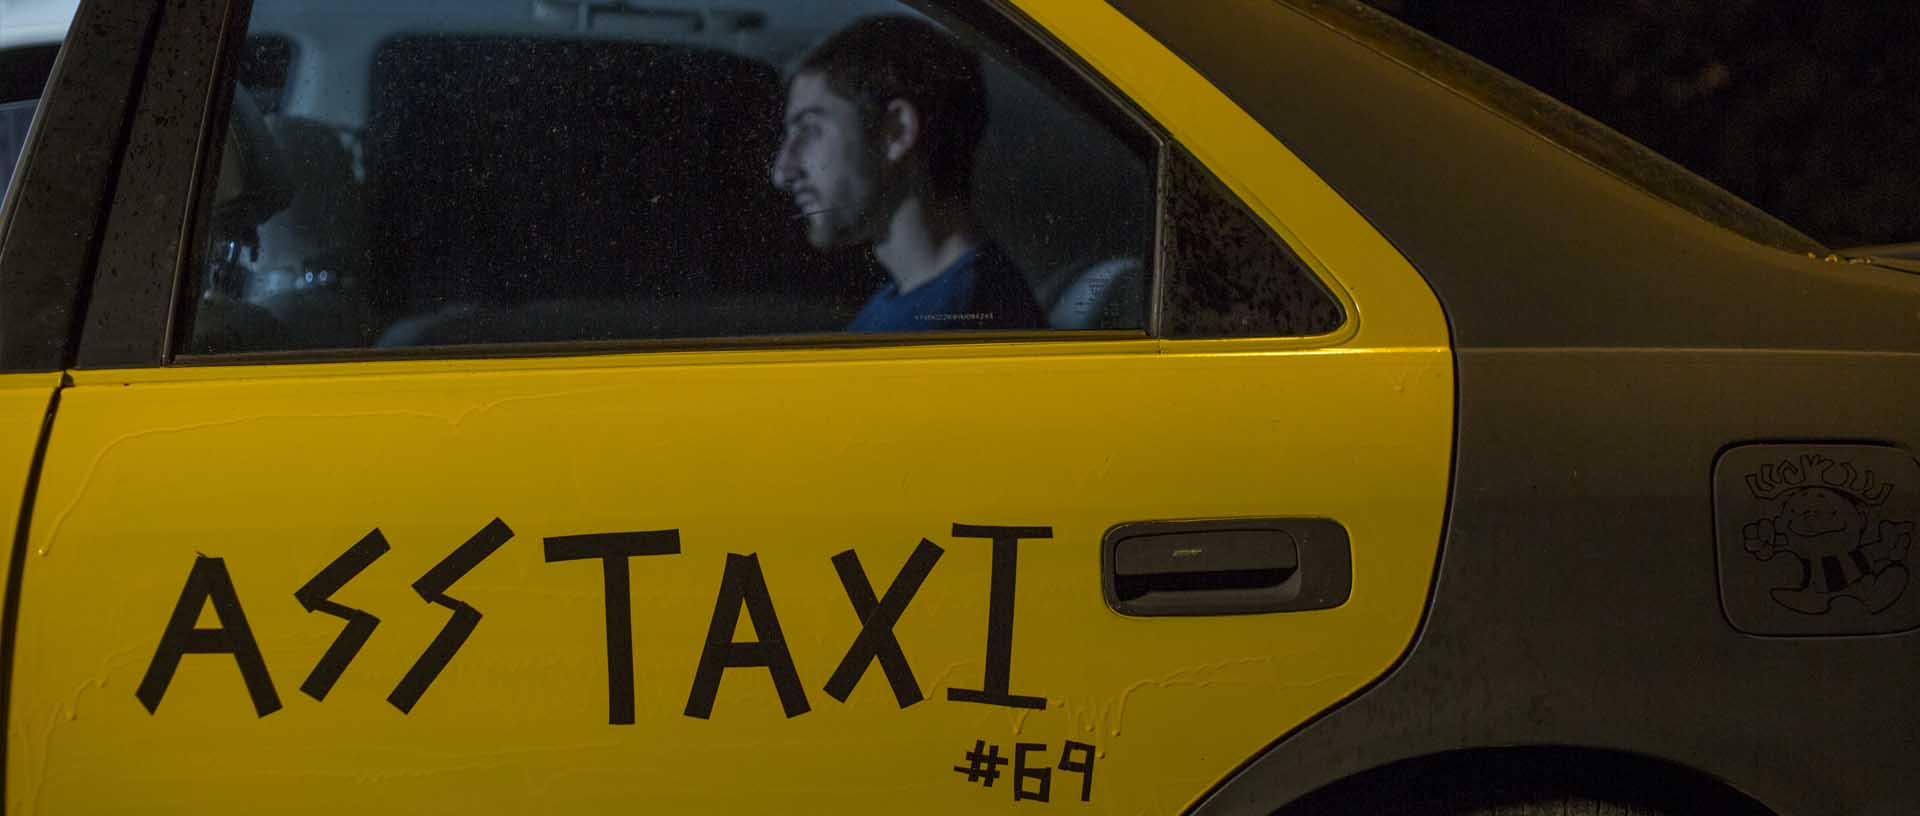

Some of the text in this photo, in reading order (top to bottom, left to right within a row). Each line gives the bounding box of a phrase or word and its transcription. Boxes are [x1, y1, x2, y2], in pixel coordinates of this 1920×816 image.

[134, 516, 1053, 726] ASS TAXI
[953, 739, 1097, 803] #69
